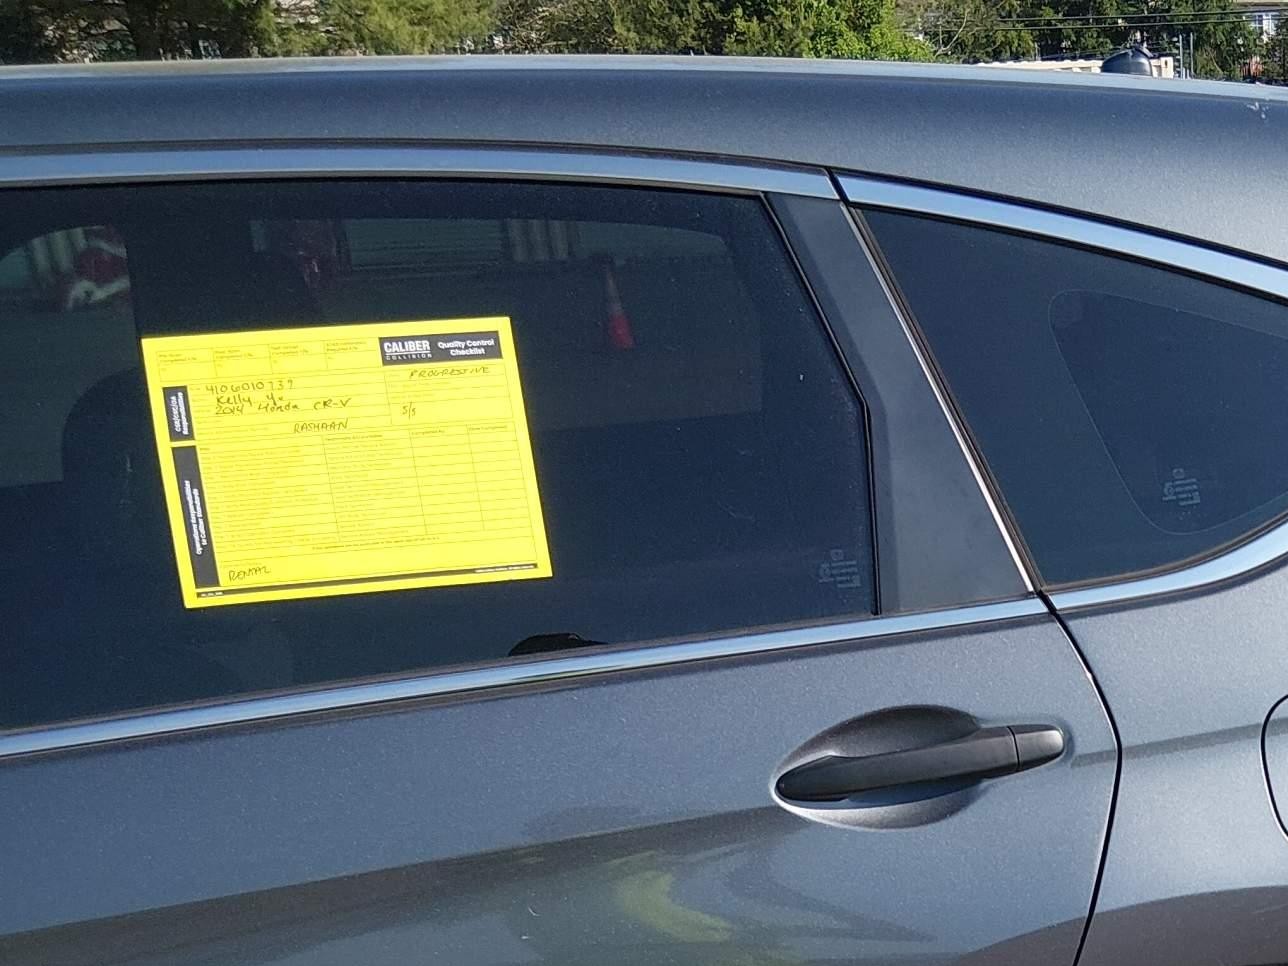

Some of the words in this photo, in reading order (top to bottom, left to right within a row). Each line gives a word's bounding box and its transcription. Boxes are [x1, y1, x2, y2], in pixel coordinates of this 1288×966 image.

[383, 340, 431, 353] CALIBER
[437, 340, 466, 350] Quality
[466, 338, 495, 347] Control
[450, 347, 486, 356] Checklist
[215, 404, 245, 415] 2014
[258, 401, 300, 415] Honda
[313, 397, 352, 410] CR-V
[216, 394, 253, 407] Kelly
